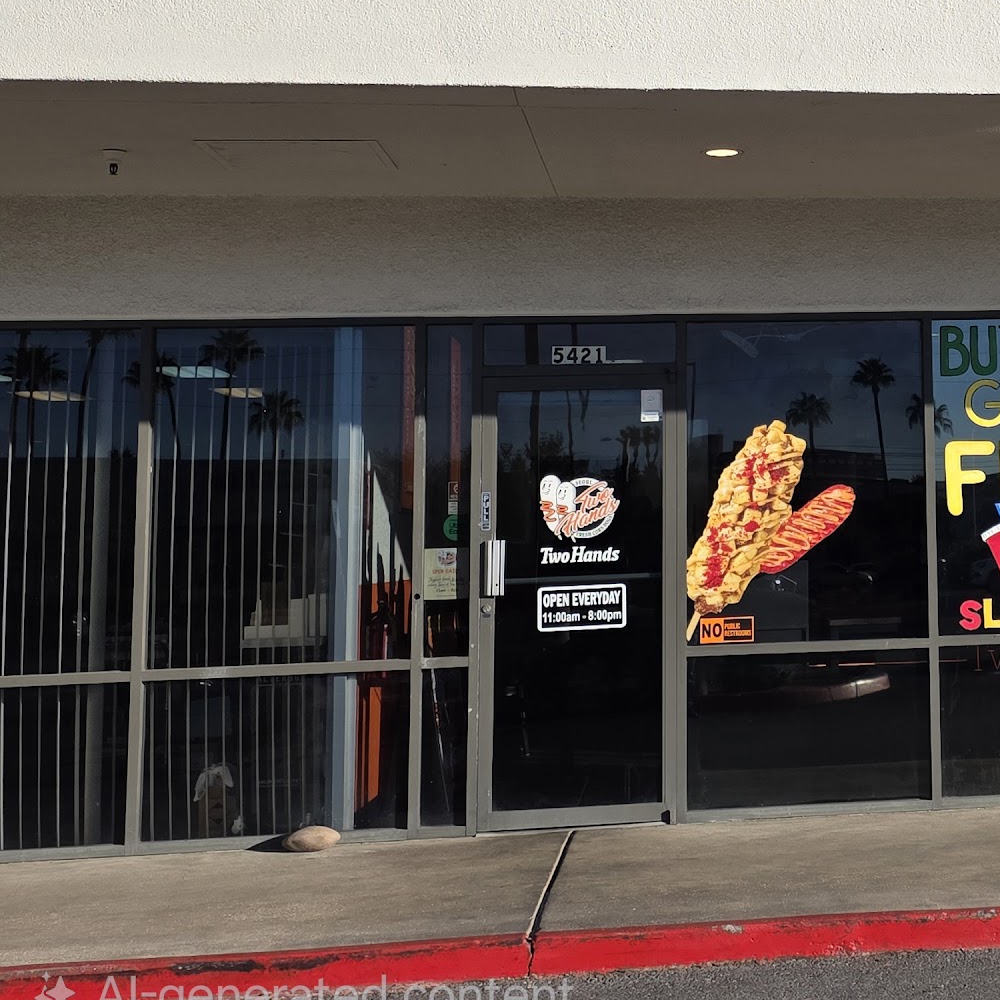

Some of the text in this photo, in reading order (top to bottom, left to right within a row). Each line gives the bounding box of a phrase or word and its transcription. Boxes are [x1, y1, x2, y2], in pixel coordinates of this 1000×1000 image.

[553, 347, 603, 364] 5421
[573, 481, 615, 514] Two
[554, 498, 621, 537] Hands
[540, 545, 620, 565] Two Hands
[543, 589, 621, 608] OPEN EVERYDAY
[542, 611, 581, 623] 11:00am
[588, 609, 622, 622] 8:00pm
[702, 622, 722, 638] NO
